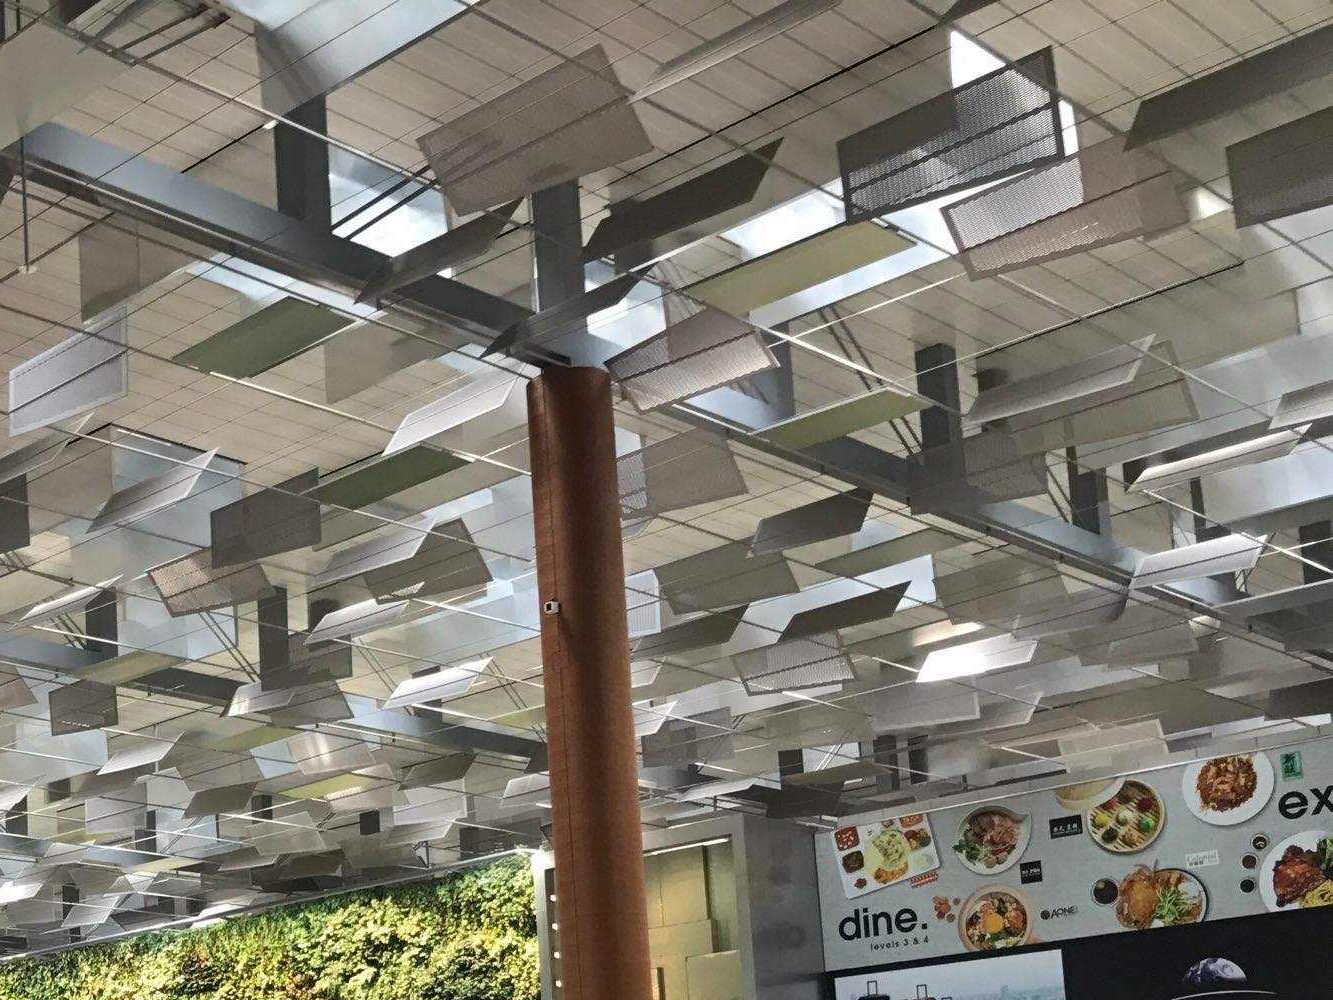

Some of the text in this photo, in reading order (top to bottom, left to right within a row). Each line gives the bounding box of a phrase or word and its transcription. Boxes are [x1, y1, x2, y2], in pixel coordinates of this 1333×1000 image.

[838, 906, 929, 942] dine.
[870, 935, 930, 952] levels 3 & 4
